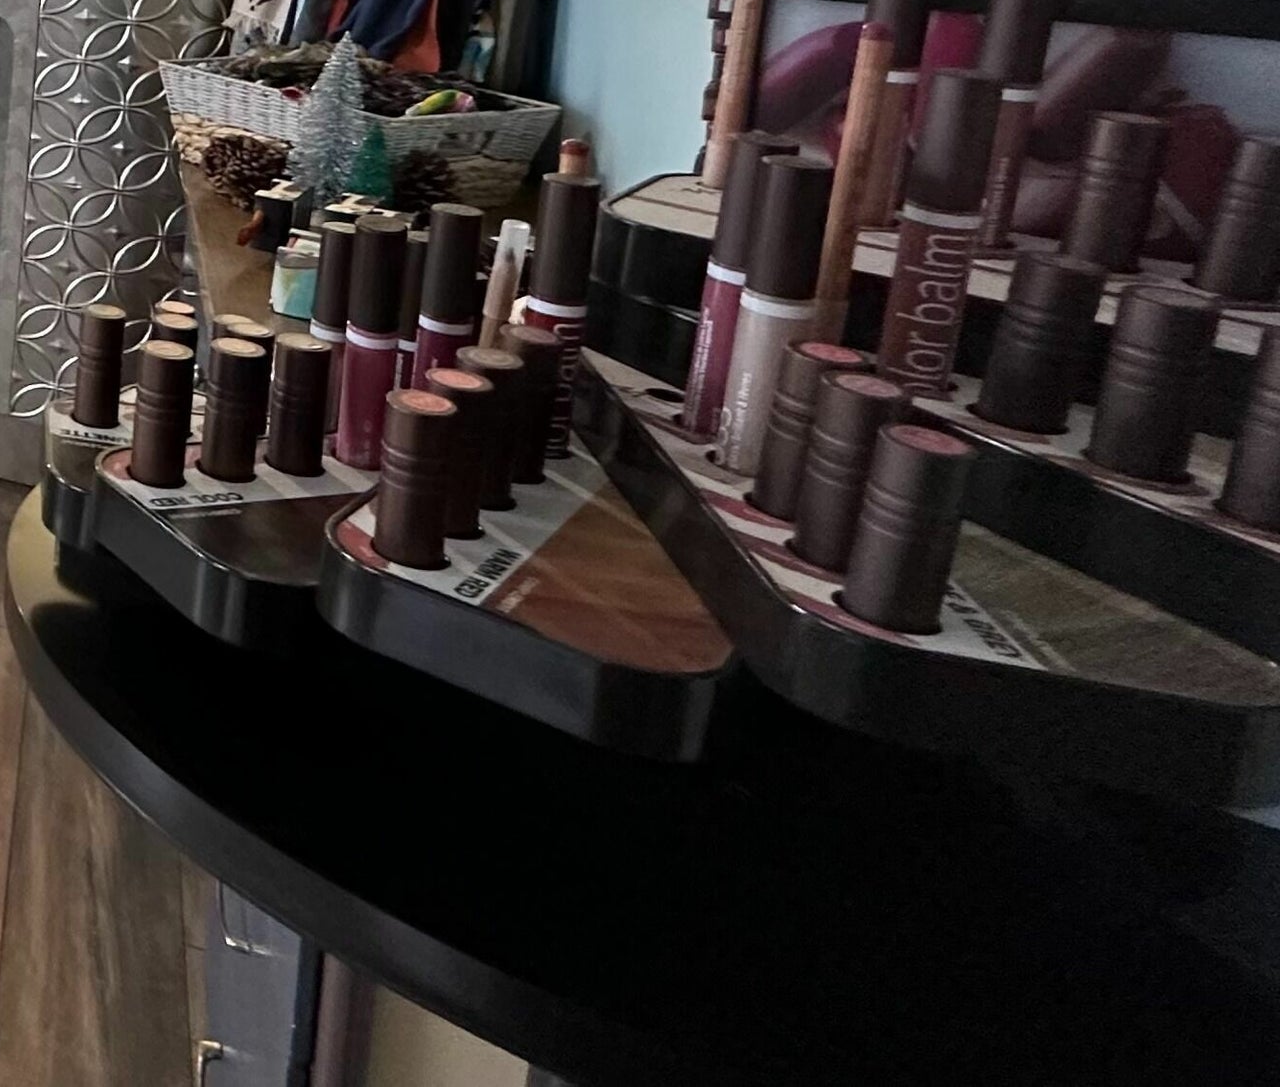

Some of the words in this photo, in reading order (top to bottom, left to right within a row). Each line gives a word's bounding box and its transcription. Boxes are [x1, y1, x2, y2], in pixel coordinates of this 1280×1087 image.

[895, 234, 970, 325] balm
[150, 496, 190, 507] RED
[191, 492, 244, 505] COOL
[473, 546, 522, 581] WARM
[453, 574, 491, 598] RED
